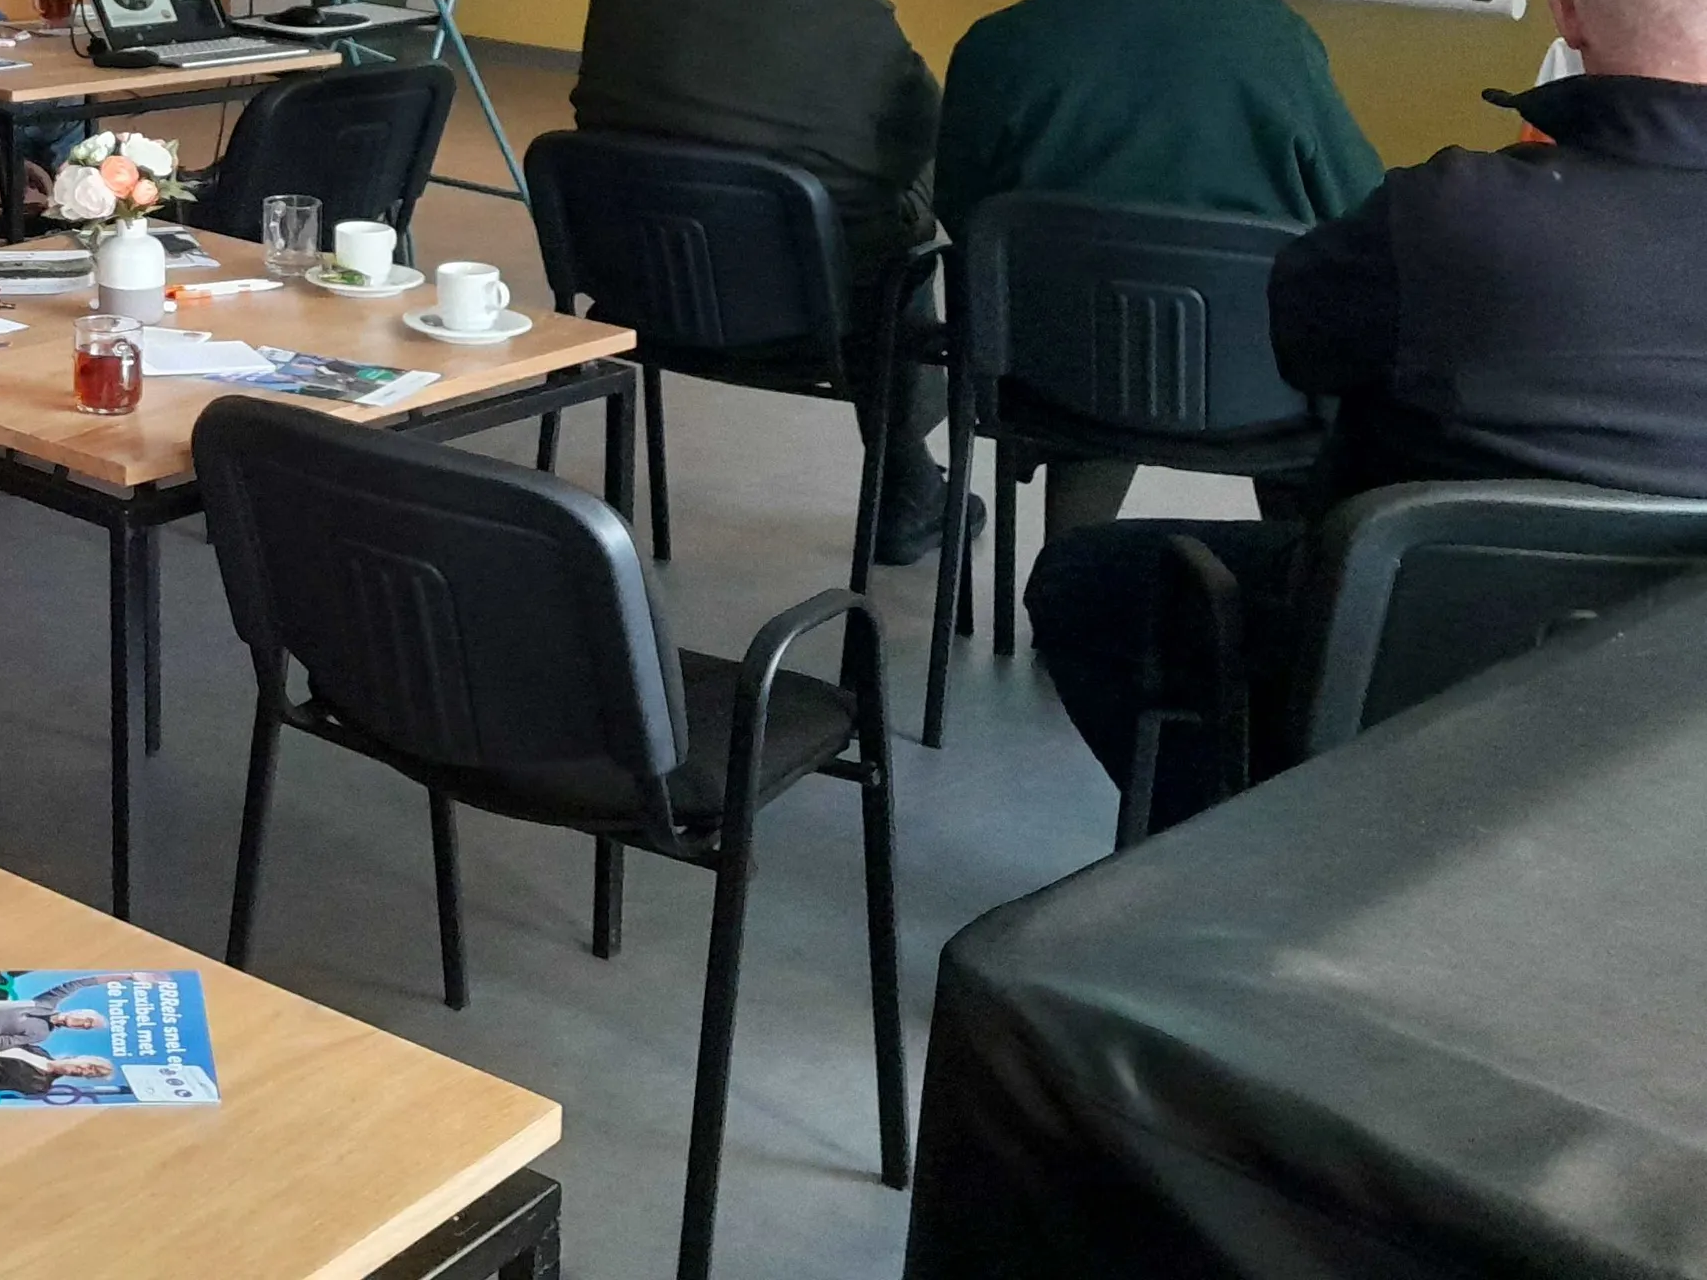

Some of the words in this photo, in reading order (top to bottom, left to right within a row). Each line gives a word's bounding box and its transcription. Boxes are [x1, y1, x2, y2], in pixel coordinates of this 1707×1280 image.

[107, 980, 128, 997] de
[132, 980, 156, 1028] flexibel
[158, 980, 182, 1024] RRReis
[108, 999, 132, 1058] haltetaxi
[137, 1029, 156, 1057] met
[163, 1026, 186, 1054] snel
